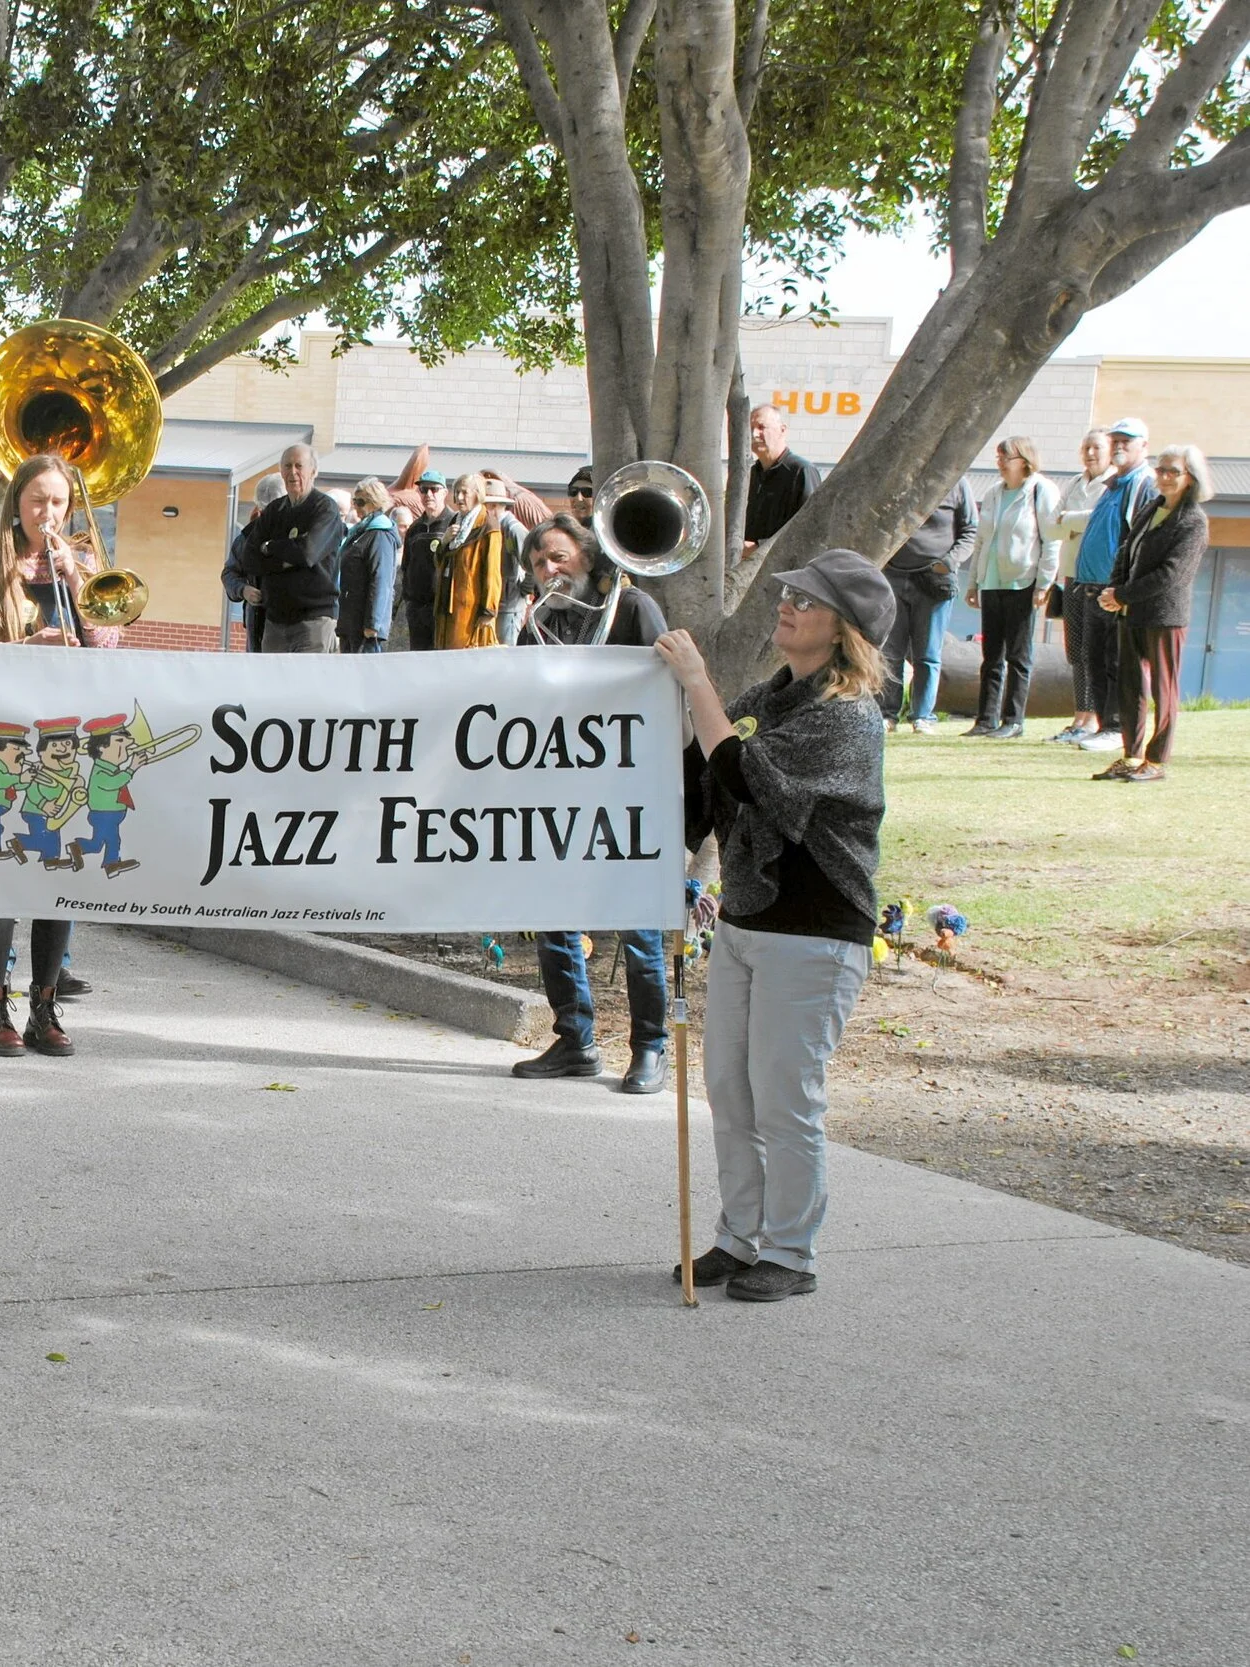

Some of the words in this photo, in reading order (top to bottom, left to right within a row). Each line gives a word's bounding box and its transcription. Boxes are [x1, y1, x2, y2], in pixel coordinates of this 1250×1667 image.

[771, 390, 862, 416] HUB
[209, 703, 419, 775] SOUTH
[455, 703, 645, 771] COAST
[199, 798, 340, 887] JAZZ
[376, 796, 662, 864] FESTIVAL
[55, 896, 127, 914] Presented
[129, 902, 148, 916] by
[150, 903, 192, 916] South
[194, 905, 268, 919] Australian
[270, 908, 300, 920] Jazz
[302, 908, 362, 921] Festivals
[364, 909, 386, 921] Inc
